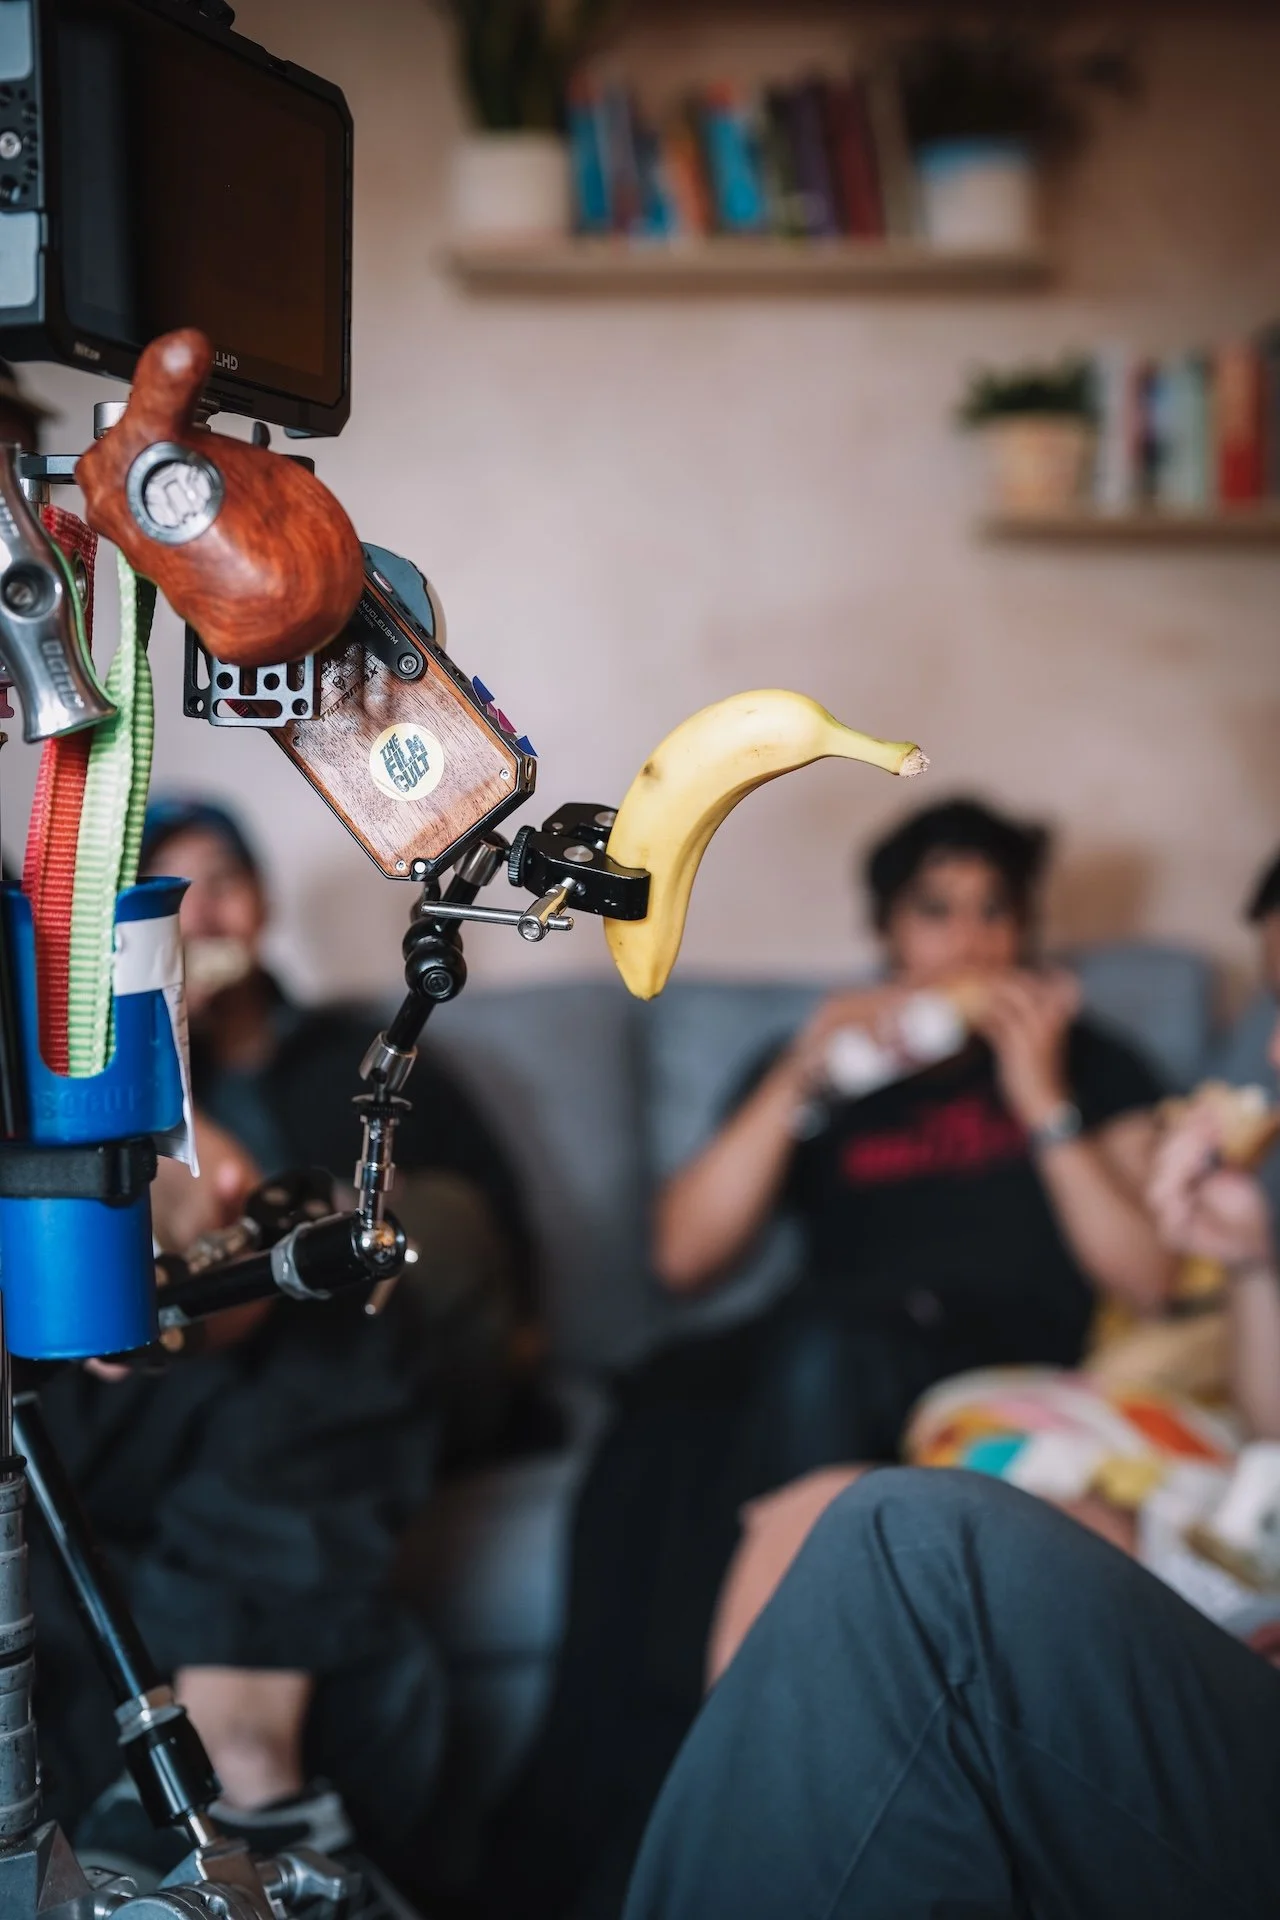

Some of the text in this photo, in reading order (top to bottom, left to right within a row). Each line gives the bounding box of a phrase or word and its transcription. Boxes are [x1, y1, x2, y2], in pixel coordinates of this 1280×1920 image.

[212, 351, 239, 371] LHD
[360, 600, 399, 645] NUCLEUS-M
[380, 733, 400, 761] THE
[384, 734, 428, 780] FILM
[393, 751, 430, 793] CULT
